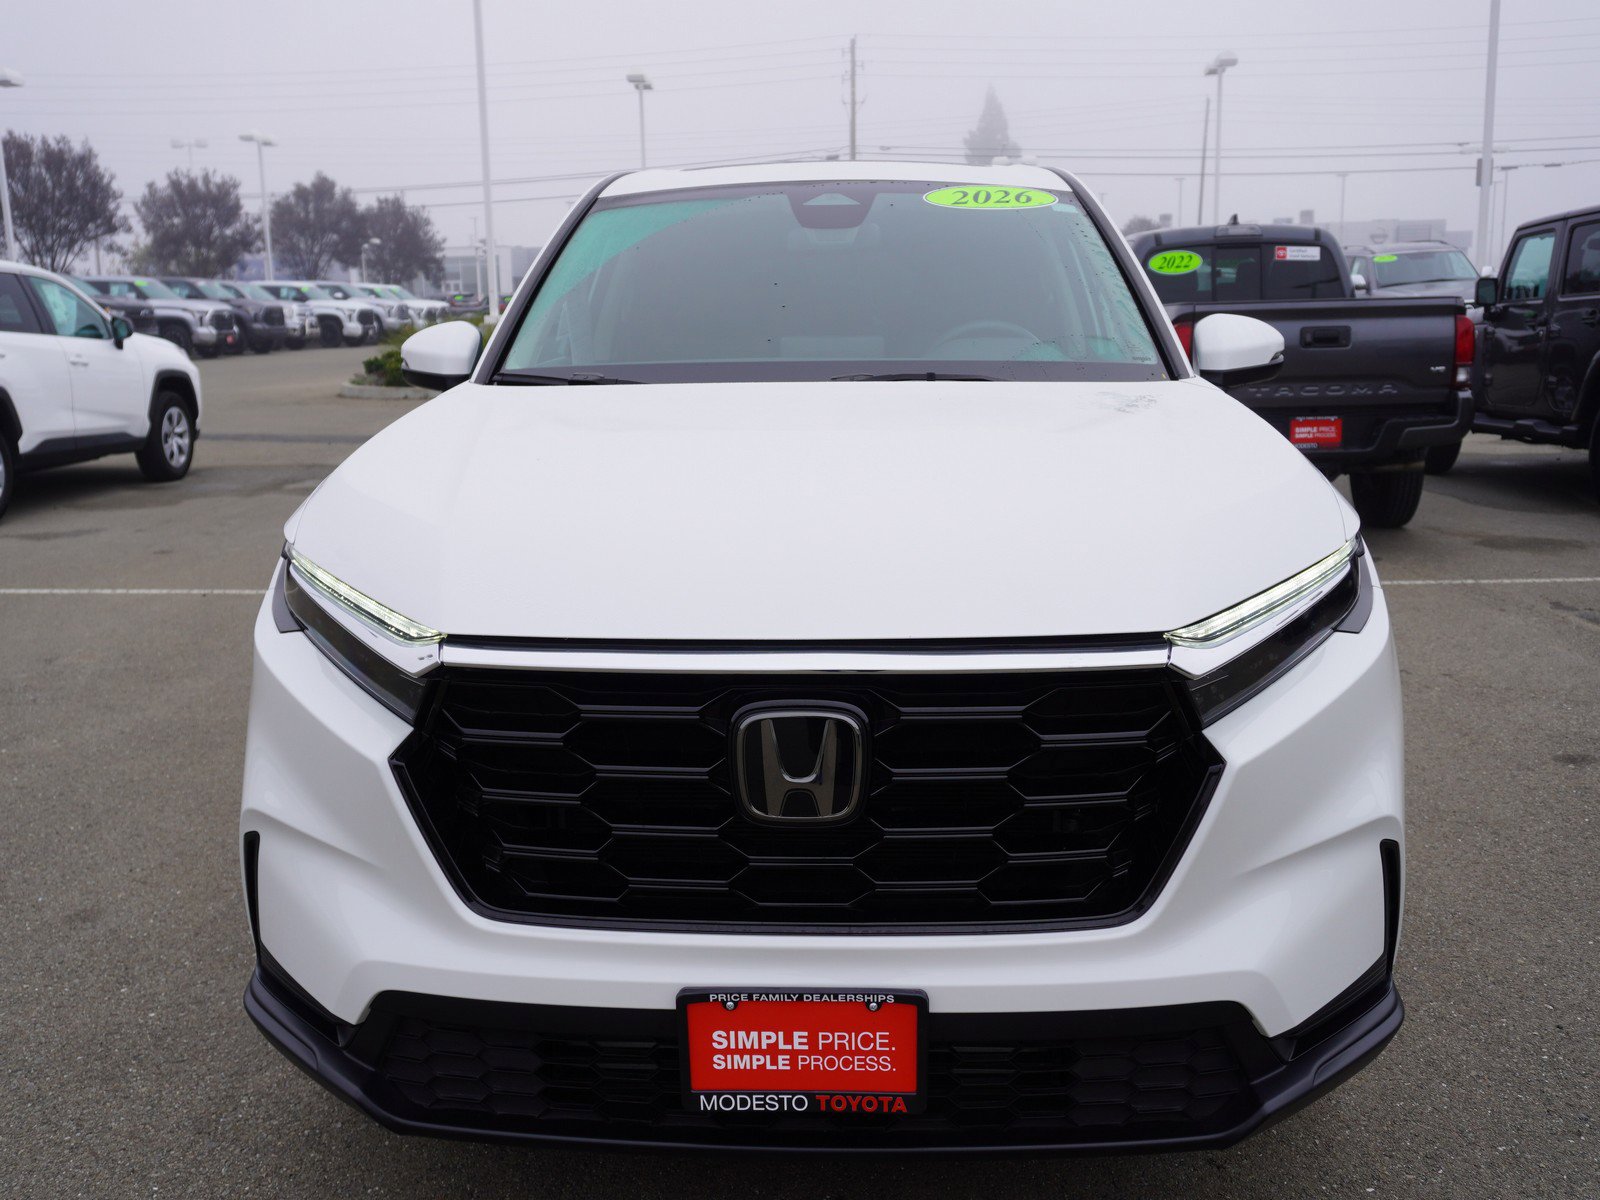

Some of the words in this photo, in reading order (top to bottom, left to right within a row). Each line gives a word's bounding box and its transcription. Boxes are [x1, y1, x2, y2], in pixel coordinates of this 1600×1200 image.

[951, 189, 1032, 205] 2026
[1158, 255, 1192, 270] 2022
[1248, 384, 1398, 397] TACOMA
[709, 993, 749, 1002] PRICE
[752, 993, 799, 1003] FAMILY
[803, 994, 895, 1004] DEALERSHIPS
[712, 1030, 809, 1050] SIMPLE
[818, 1031, 896, 1051] PRICE.
[712, 1054, 790, 1070] SIMPLE
[798, 1055, 896, 1072] PROCESS.
[700, 1094, 809, 1111] MODESTO
[815, 1095, 908, 1113] TOYOTA
